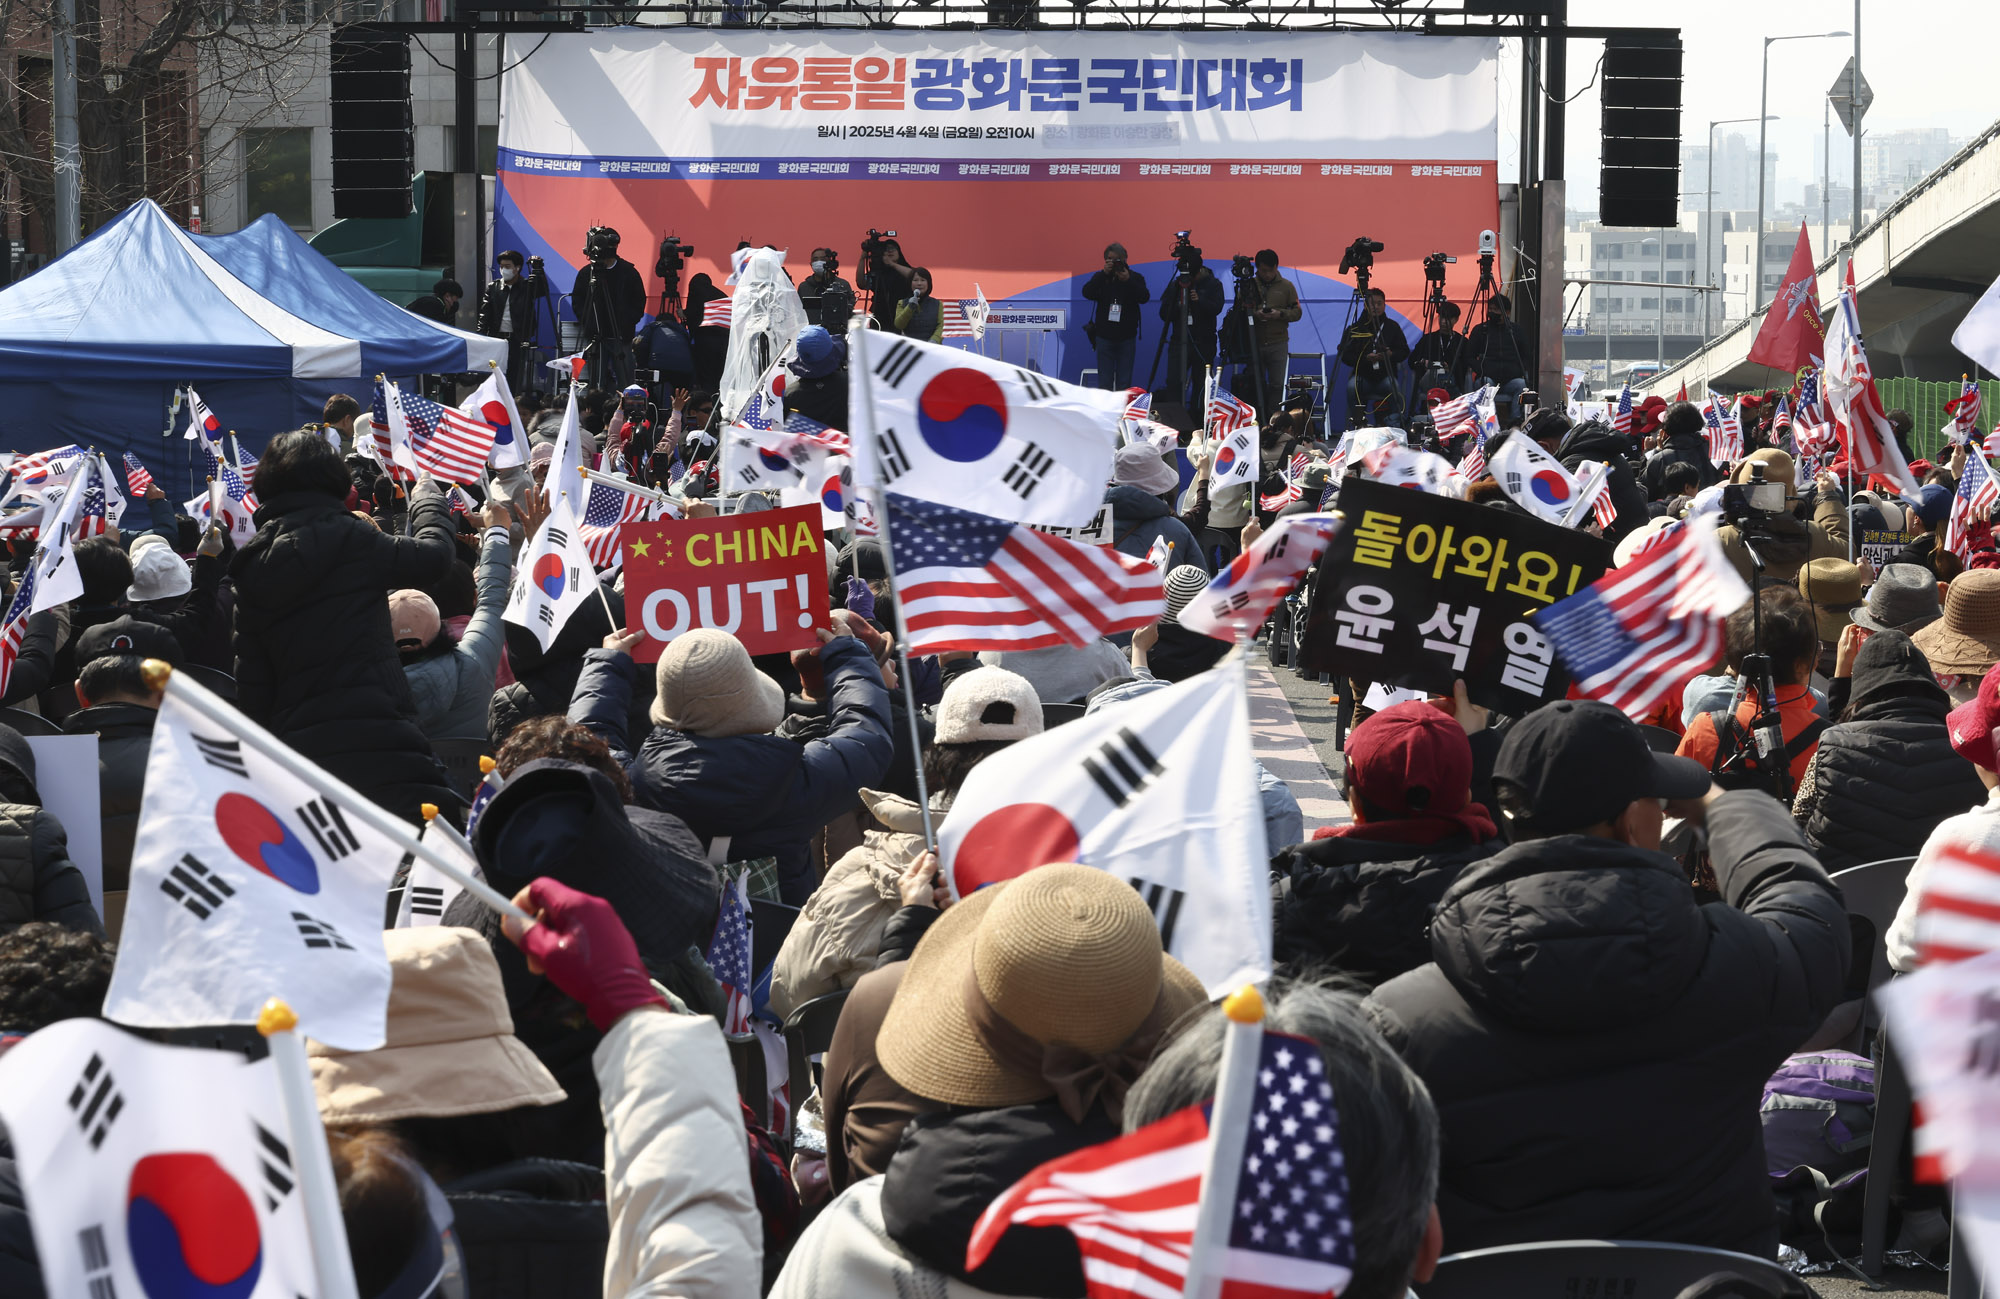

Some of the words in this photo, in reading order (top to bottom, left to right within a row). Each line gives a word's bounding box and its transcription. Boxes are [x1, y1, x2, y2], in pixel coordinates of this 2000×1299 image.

[817, 125, 840, 138] 일시
[849, 125, 894, 138] 2025년
[895, 125, 917, 138] 4월
[918, 126, 939, 139] 4일
[942, 126, 983, 139] (금요일)
[985, 127, 1035, 139] 오전10시
[1803, 309, 1819, 329] Once
[685, 521, 819, 567] CHINA
[1352, 509, 1583, 604] 돌아와요!
[641, 573, 814, 643] OUT!
